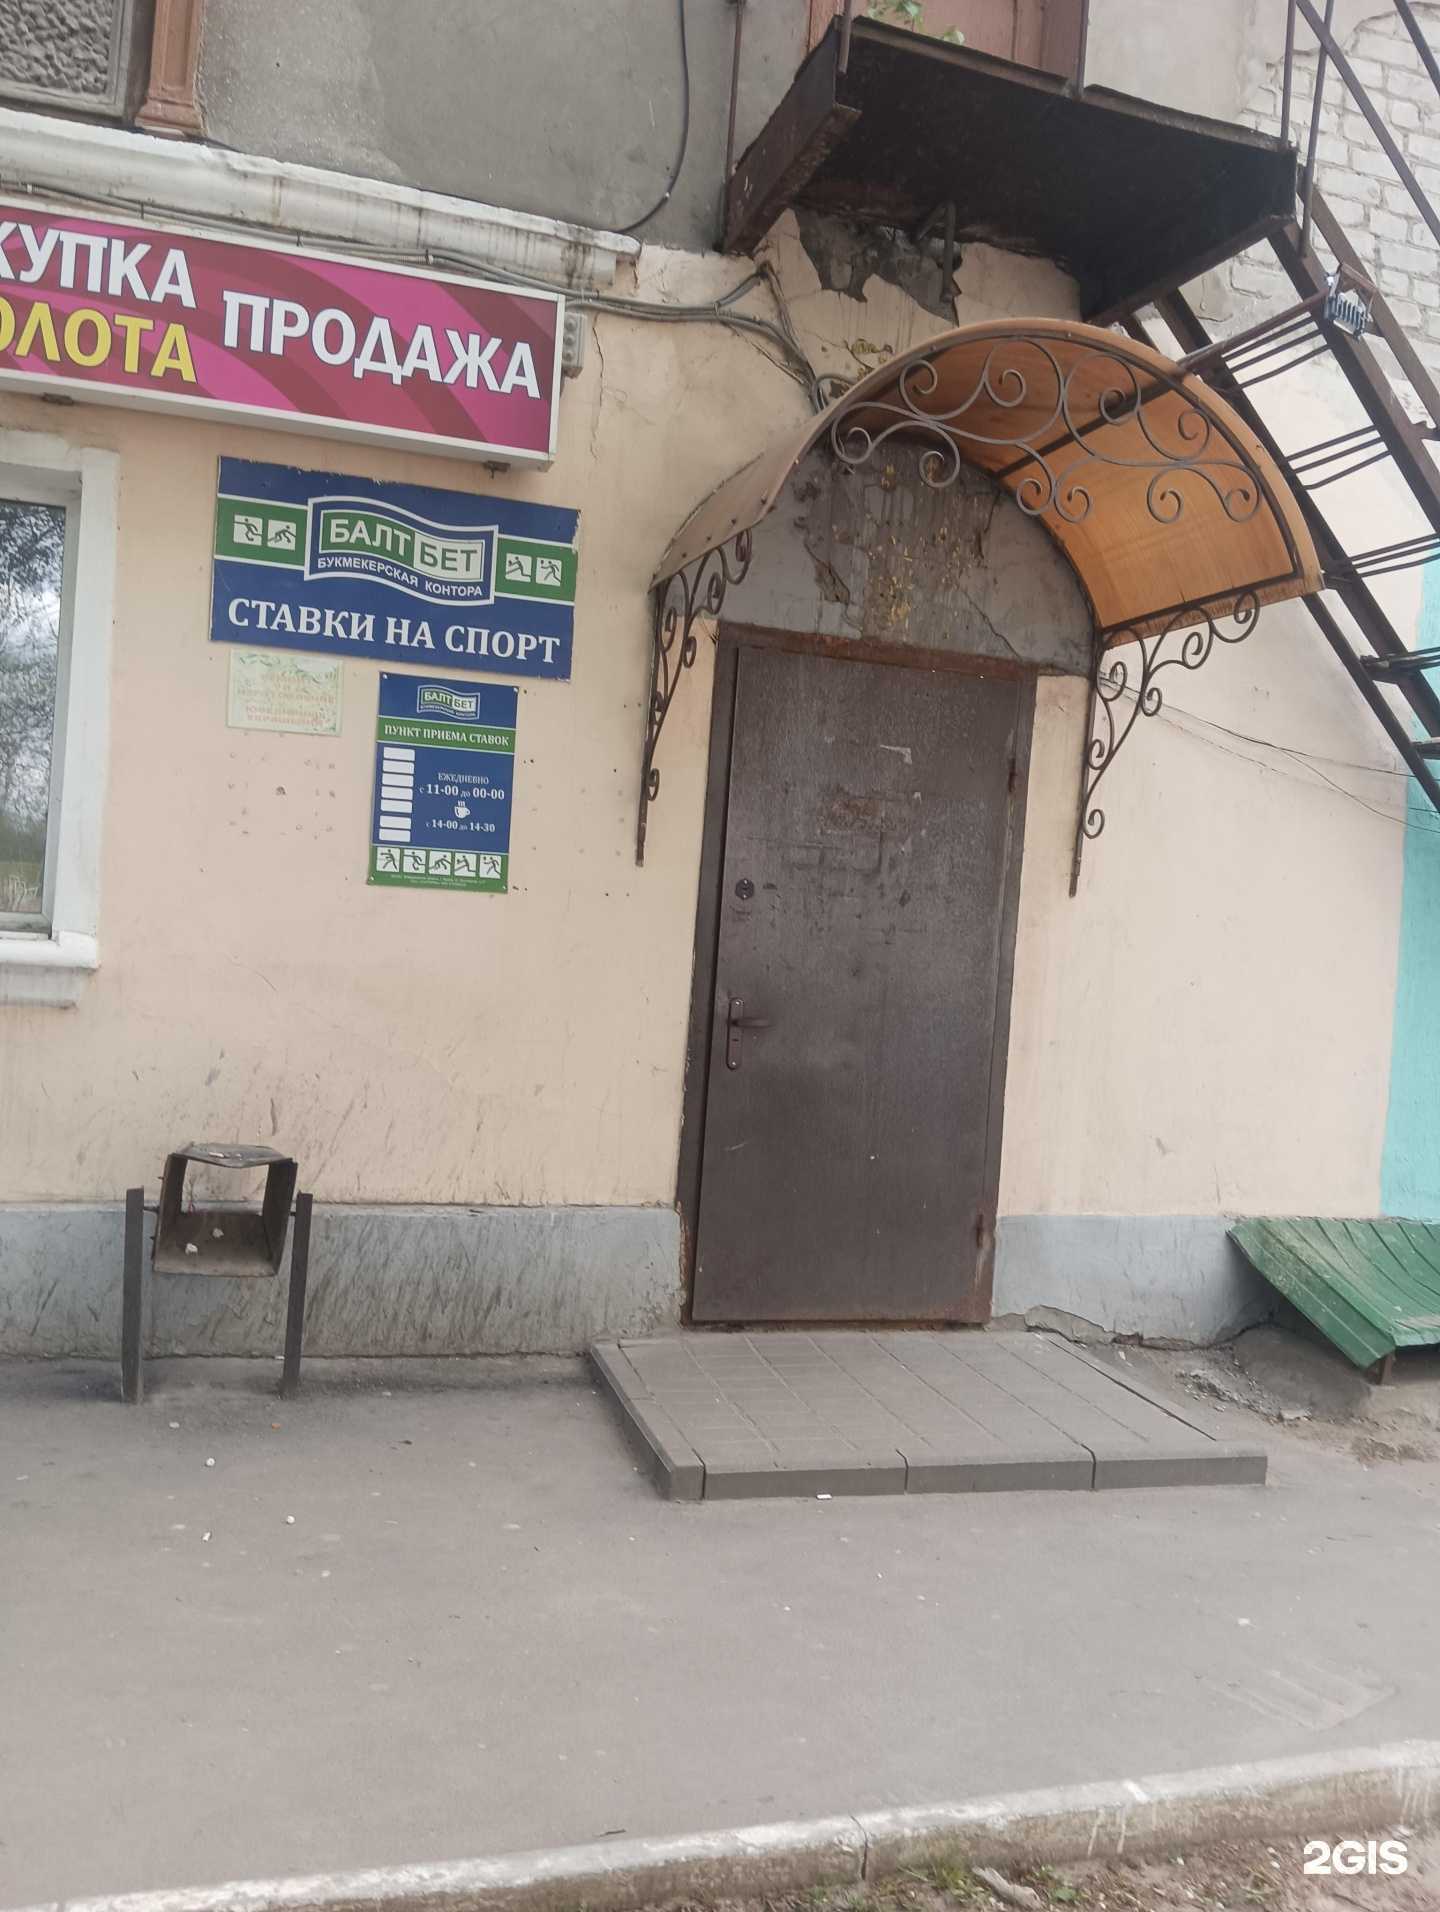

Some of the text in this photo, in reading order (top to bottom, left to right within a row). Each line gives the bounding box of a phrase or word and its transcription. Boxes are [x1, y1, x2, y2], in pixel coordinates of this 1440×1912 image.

[221, 289, 542, 399] ПРОДАЖА
[317, 556, 483, 597] БУКМЕКЕРСКАЯ КОНТОРА
[228, 597, 561, 664] СТАВКИ НА СПОРТ
[384, 724, 510, 747] ПУНКТ ПРИЕМА СТАВОК
[438, 772, 490, 785] ЕЖЕДНЕВНО
[426, 783, 459, 796] 11-00
[460, 790, 471, 799] до
[472, 787, 505, 800] 00-00
[432, 819, 458, 830] 14-00
[469, 821, 496, 833] 14-30
